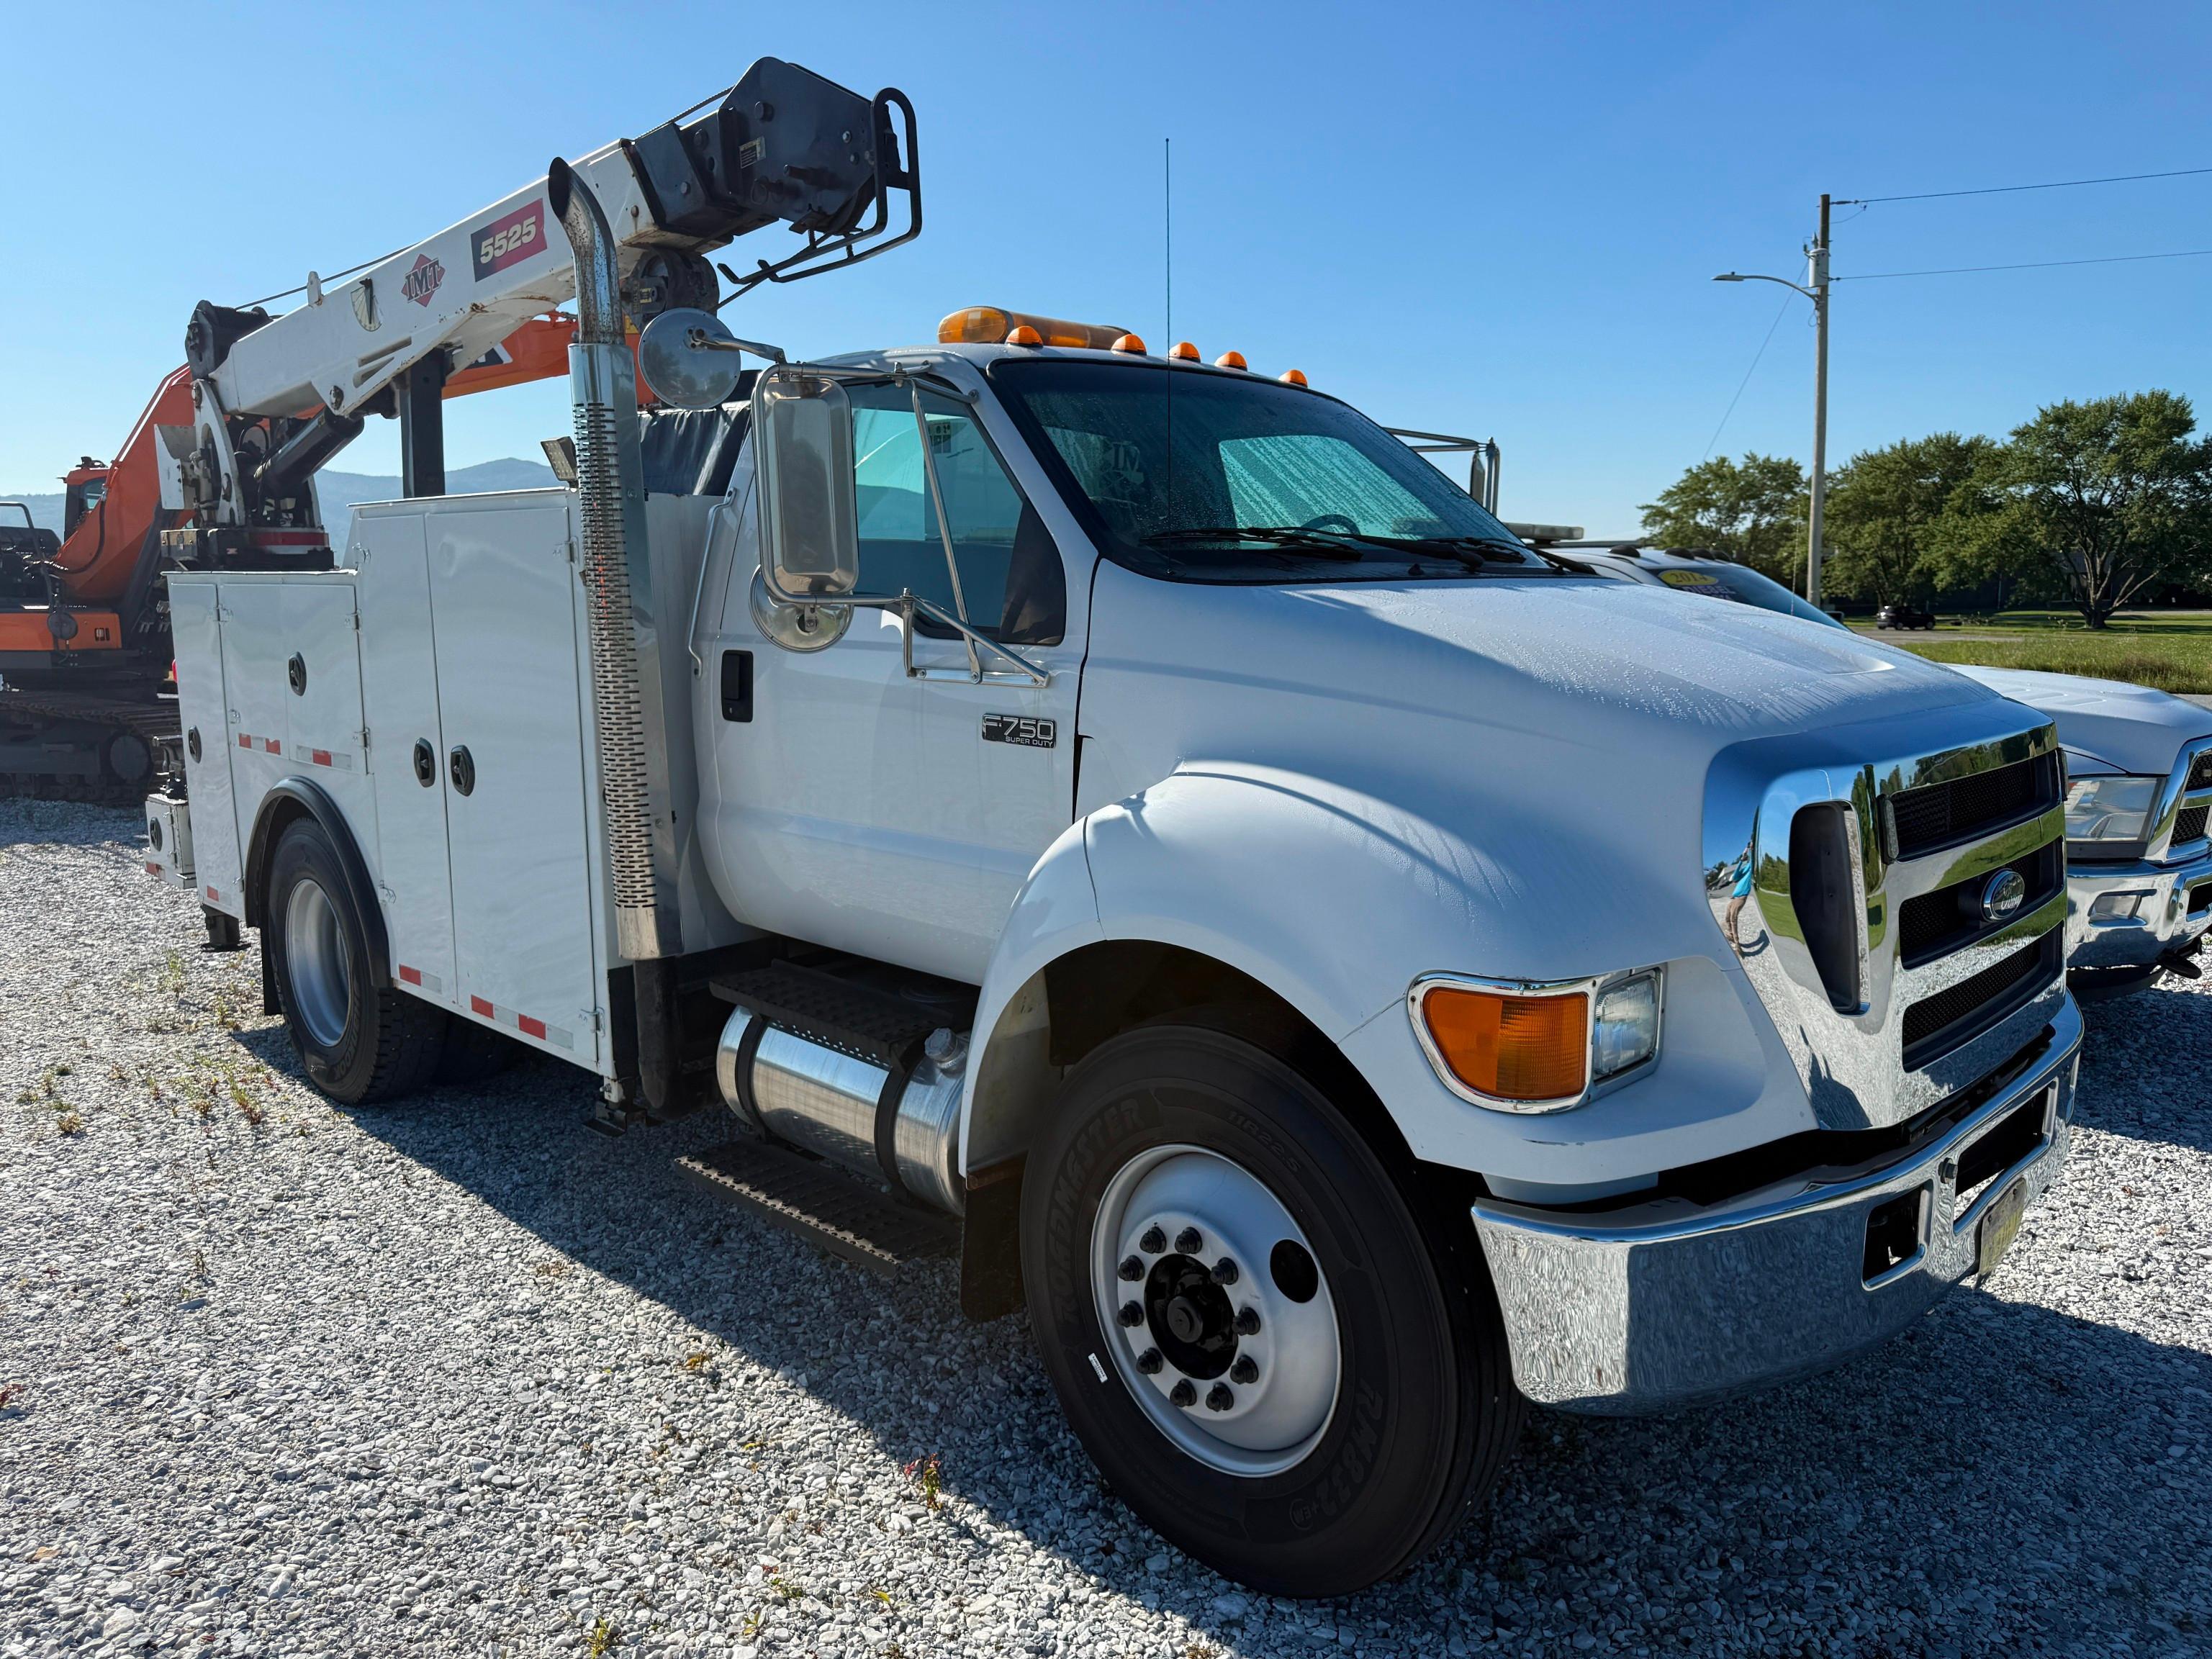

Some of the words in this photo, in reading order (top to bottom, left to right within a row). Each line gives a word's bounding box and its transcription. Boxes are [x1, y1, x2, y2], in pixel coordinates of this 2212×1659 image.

[480, 216, 536, 264] 5525
[405, 260, 441, 302] IMT
[1670, 573, 1707, 583] 2014
[1005, 736, 1031, 746] SUPER
[1032, 739, 1054, 748] DUTY
[1049, 1098, 1145, 1325] ROADMASTER
